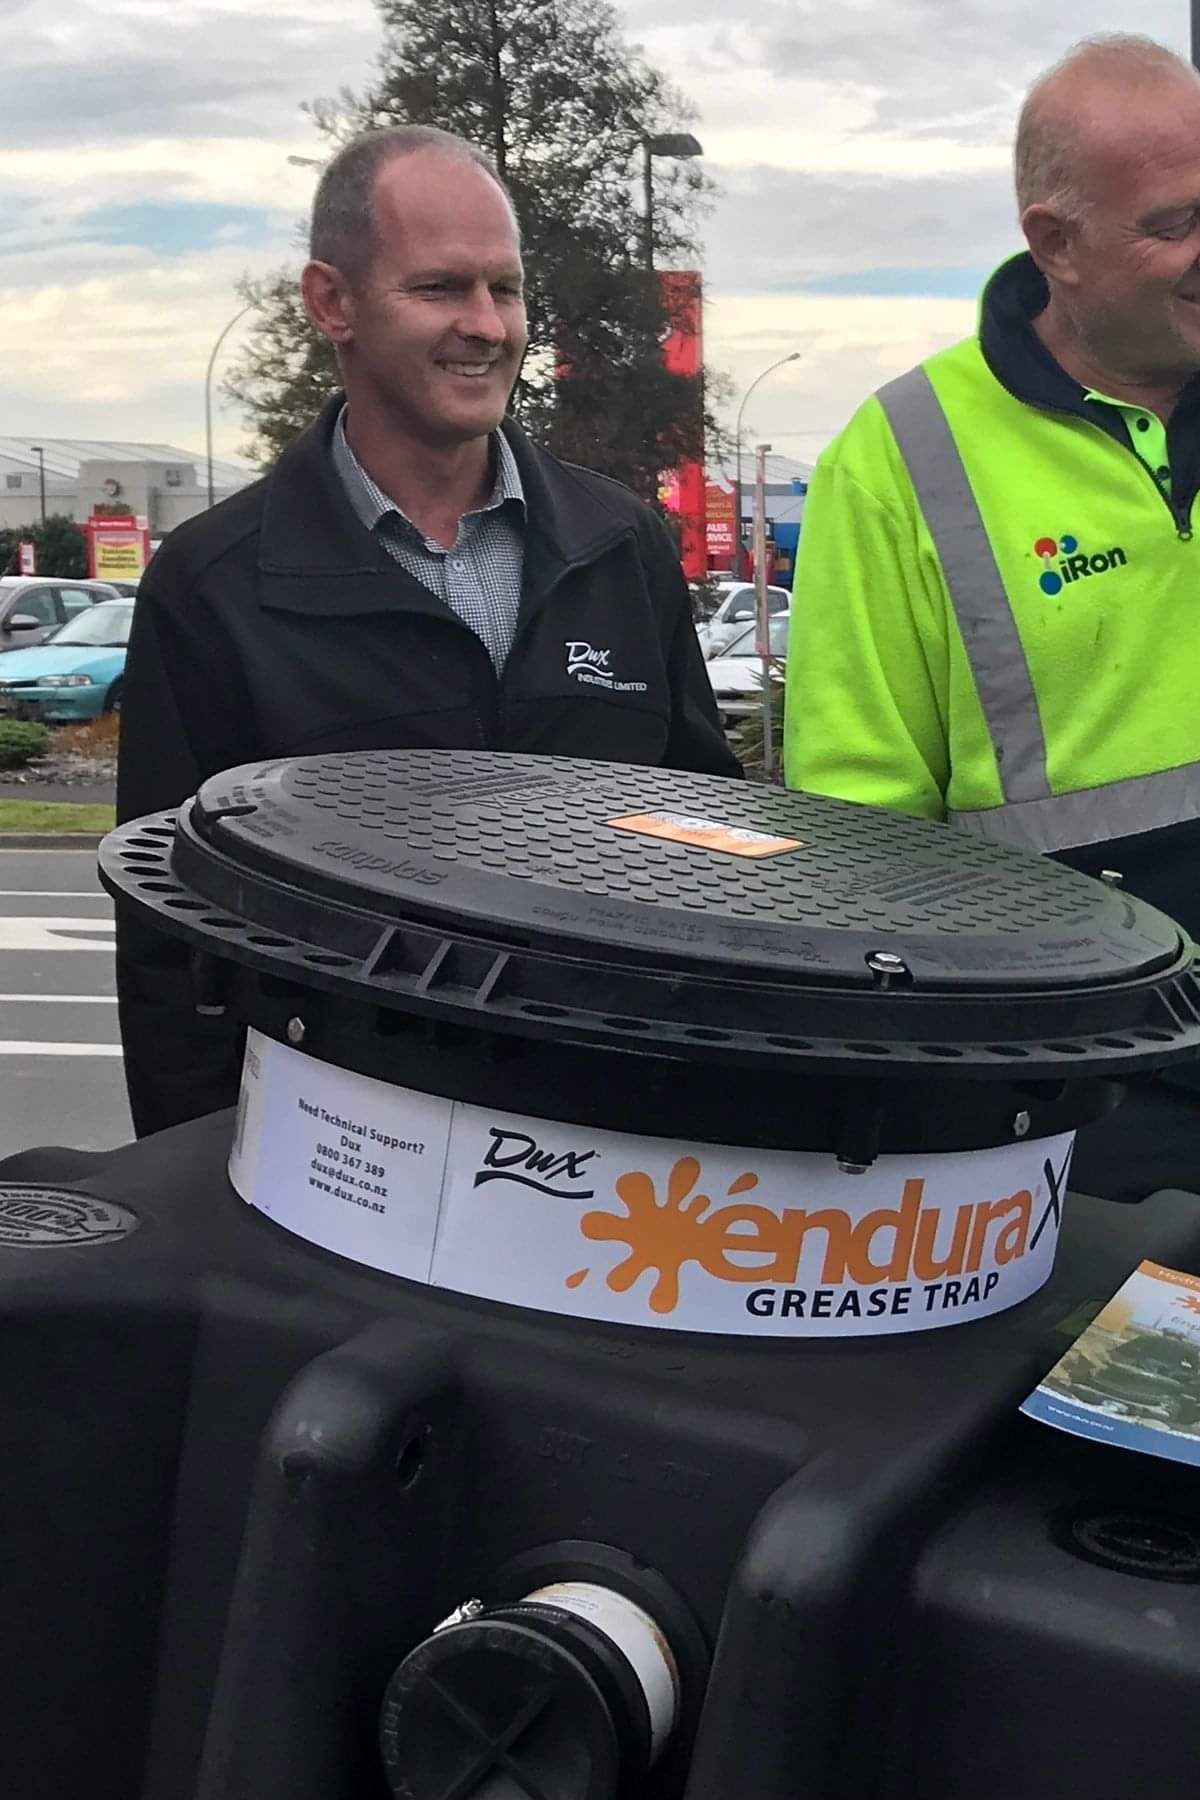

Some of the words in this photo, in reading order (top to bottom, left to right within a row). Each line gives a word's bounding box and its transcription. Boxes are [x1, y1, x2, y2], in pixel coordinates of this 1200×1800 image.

[706, 523, 728, 532] ALES
[1059, 546, 1128, 584] iRon
[565, 641, 610, 666] Dux
[298, 1097, 320, 1118] Need
[320, 1109, 367, 1137] Technical
[369, 1128, 425, 1155] Support?
[340, 1135, 361, 1153] Dux
[316, 1143, 340, 1162] 0800
[341, 1153, 362, 1170] 367
[363, 1162, 385, 1179] 389
[485, 1127, 596, 1180] Dux
[308, 1176, 387, 1214] www.dux.co.nz
[310, 1158, 388, 1198] dux@dux.co.nz
[745, 1286, 911, 1318] GREASE
[923, 1271, 1000, 1312] TRAP
